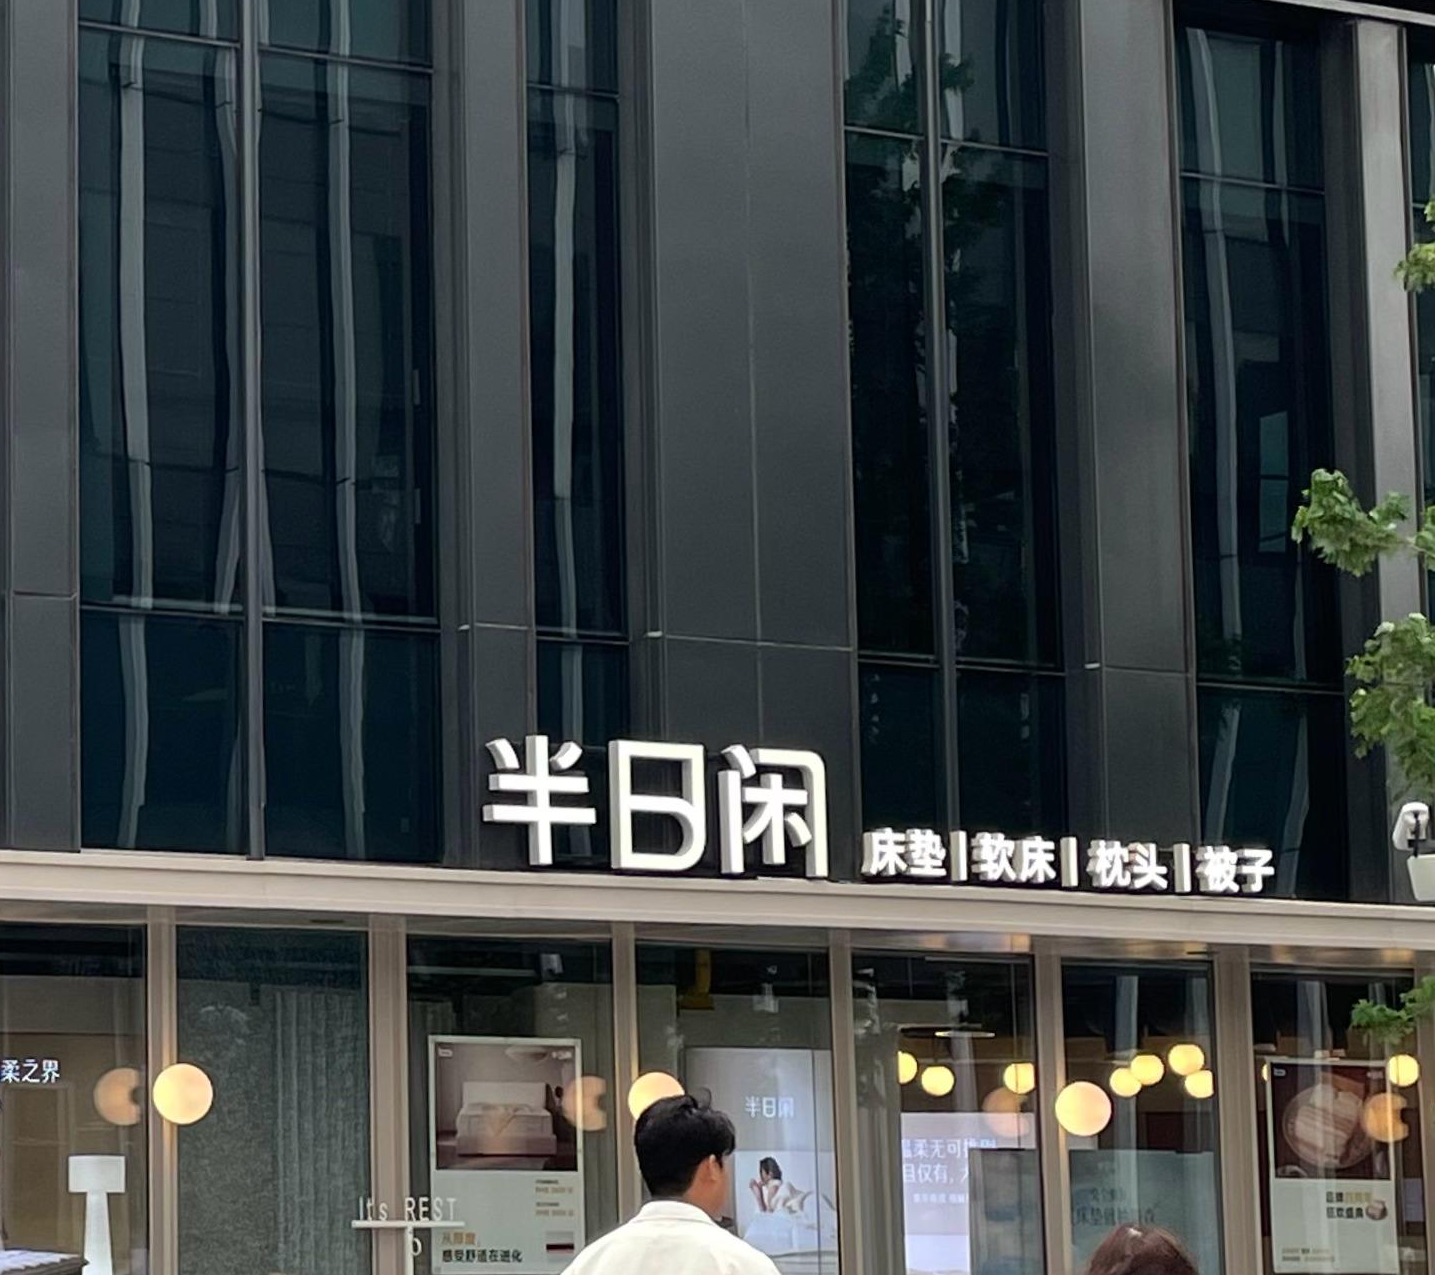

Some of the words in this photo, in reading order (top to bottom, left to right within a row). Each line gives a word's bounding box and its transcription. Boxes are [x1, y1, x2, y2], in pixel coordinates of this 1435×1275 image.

[482, 735, 828, 878] 半日闲
[861, 827, 947, 878] 床垫
[971, 832, 1056, 883] 软床
[1086, 839, 1168, 890] 枕头
[1195, 845, 1276, 894] 被子
[405, 1196, 457, 1222] REST
